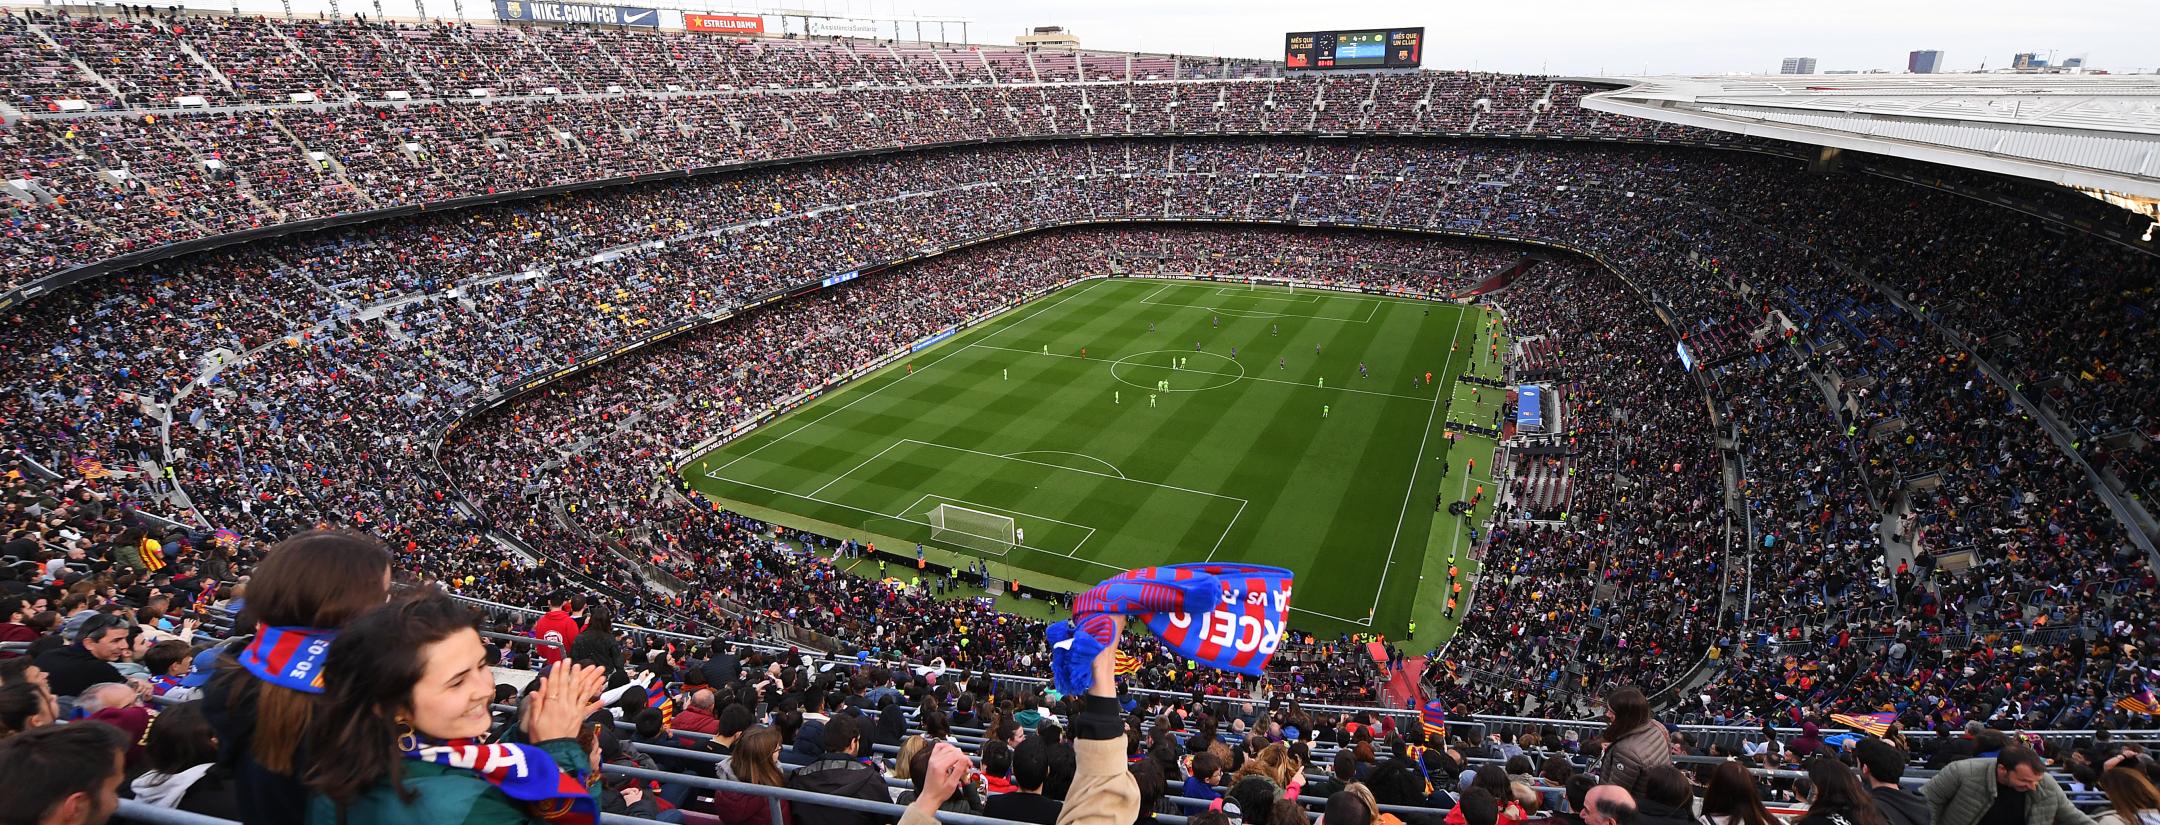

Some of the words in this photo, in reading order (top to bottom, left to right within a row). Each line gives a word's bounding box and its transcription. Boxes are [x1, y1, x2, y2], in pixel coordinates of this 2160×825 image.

[530, 3, 617, 23] NIKE.COM/FCB
[703, 19, 736, 28] ESTRELLA
[736, 21, 757, 29] DAMM
[692, 446, 707, 459] EVERY
[708, 439, 722, 451] CHILD
[733, 423, 757, 438] CHAMPION
